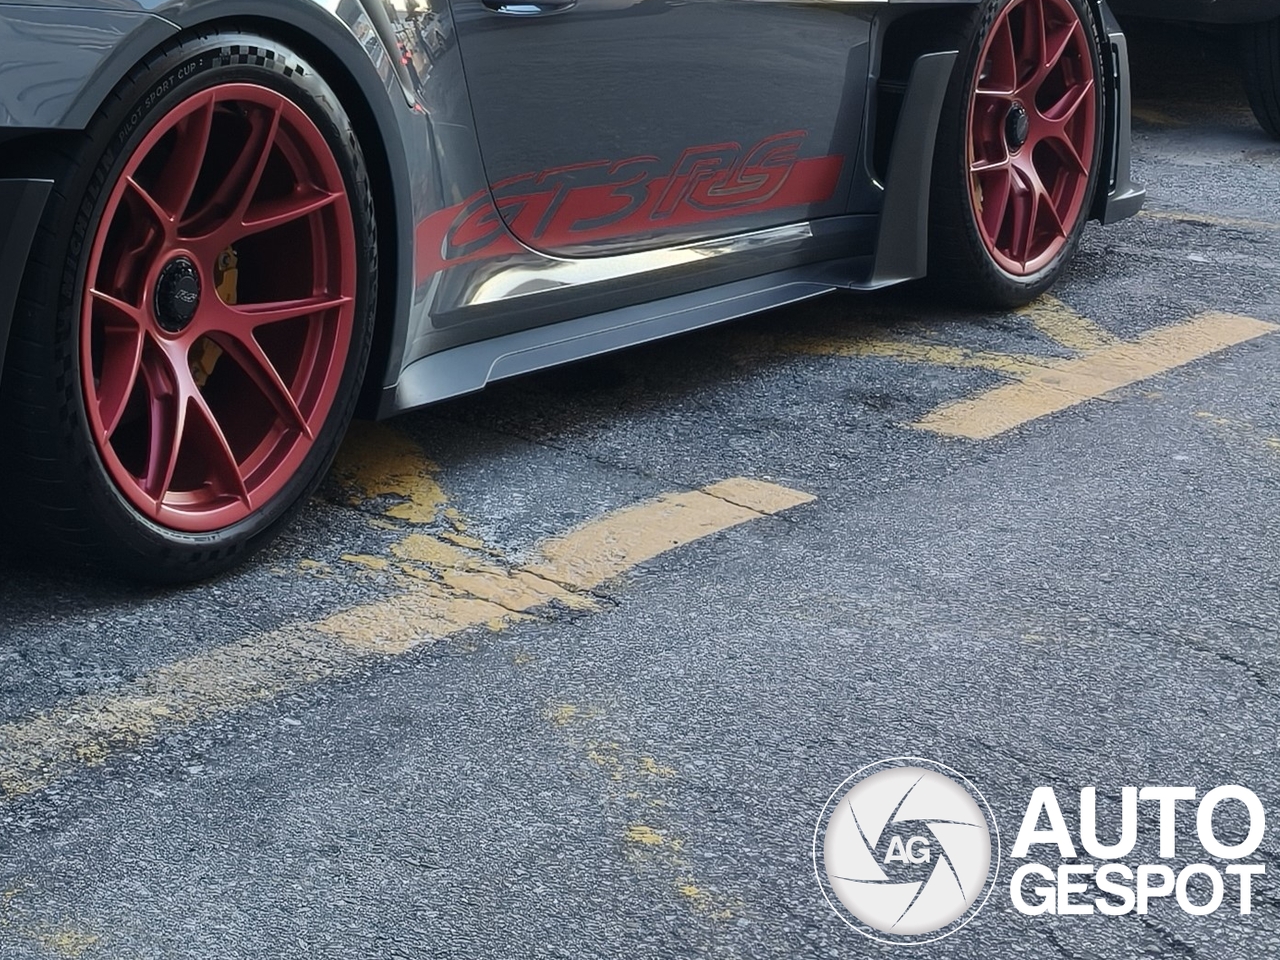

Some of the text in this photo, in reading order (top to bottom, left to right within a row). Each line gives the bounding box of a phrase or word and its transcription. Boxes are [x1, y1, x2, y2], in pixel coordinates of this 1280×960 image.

[118, 105, 143, 143] PILOT
[144, 75, 175, 109] SPORT
[177, 62, 197, 80] CUP
